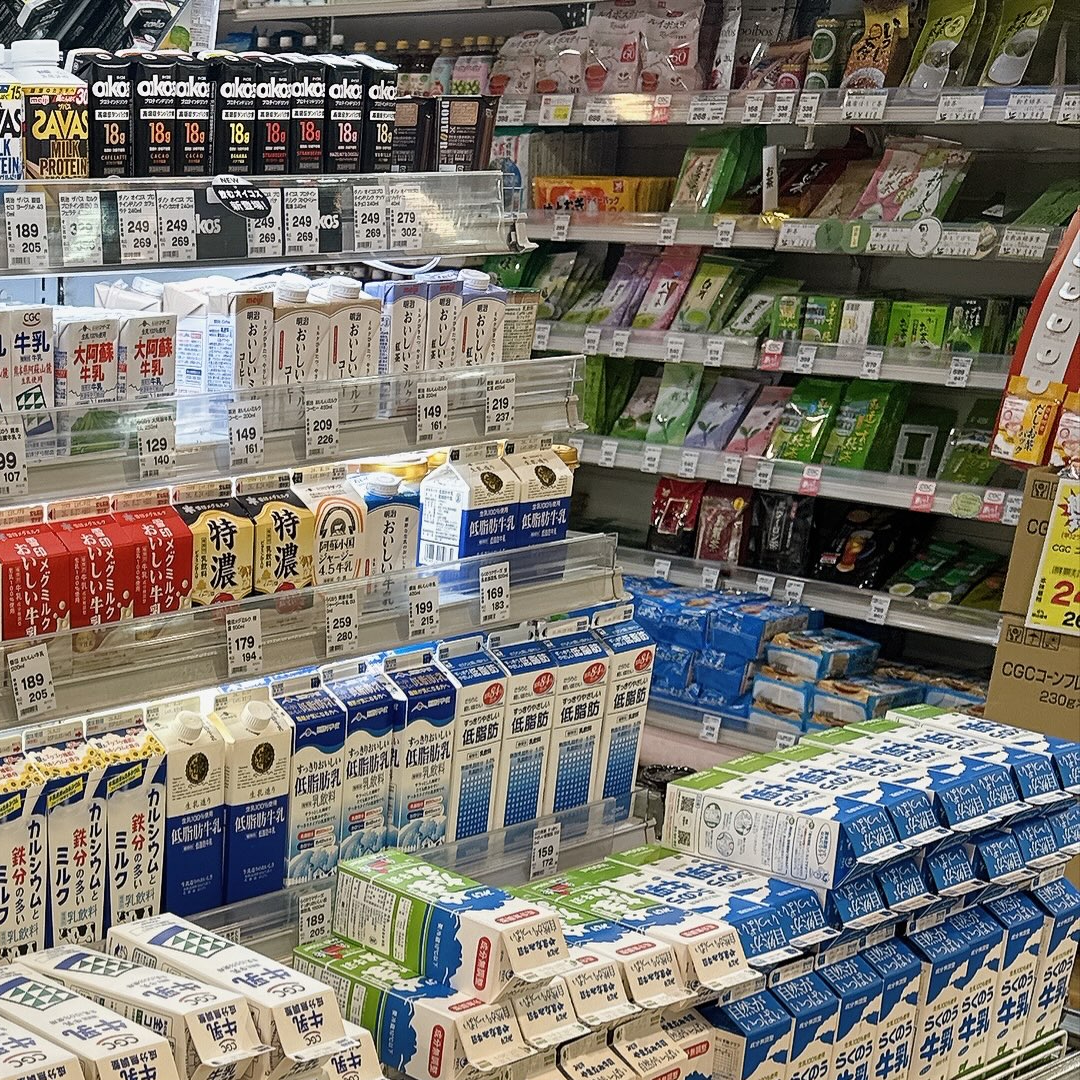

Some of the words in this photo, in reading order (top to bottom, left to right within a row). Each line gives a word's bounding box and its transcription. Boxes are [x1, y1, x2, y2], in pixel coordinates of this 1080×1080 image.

[104, 122, 126, 146] 18g
[229, 122, 250, 144] 18g
[397, 212, 415, 223] 279
[16, 223, 39, 238] 189
[128, 220, 150, 233] 249
[401, 227, 417, 237] 302
[22, 242, 41, 253] 205
[133, 238, 151, 248] 269
[14, 332, 50, 354] 牛乳
[74, 344, 114, 364] 大阿蘇
[80, 365, 105, 382] 牛乳
[492, 398, 509, 410] 219
[496, 412, 510, 422] 237
[313, 419, 332, 431] 209
[236, 427, 256, 440] 149
[146, 438, 167, 451] 129
[3, 471, 20, 482] 107
[521, 508, 567, 530] 低脂肪牛乳
[208, 518, 238, 590] 特濃
[415, 601, 433, 614] 199
[332, 616, 352, 630] 259
[336, 630, 353, 642] 280
[234, 636, 255, 651] 179
[241, 651, 257, 662] 194
[21, 673, 45, 691] 189
[29, 689, 48, 703] 205
[462, 722, 499, 746] 低脂肪
[296, 757, 342, 774] すっきりおいしい
[294, 774, 342, 797] 低脂肪乳
[171, 817, 222, 846] 低脂肪牛乳
[537, 845, 554, 858] 159
[541, 858, 554, 866] 172
[28, 819, 43, 921] カルシウムと
[12, 846, 28, 926] 鉄分の多い
[305, 913, 325, 927] 189
[7, 922, 39, 945] 乳飲料
